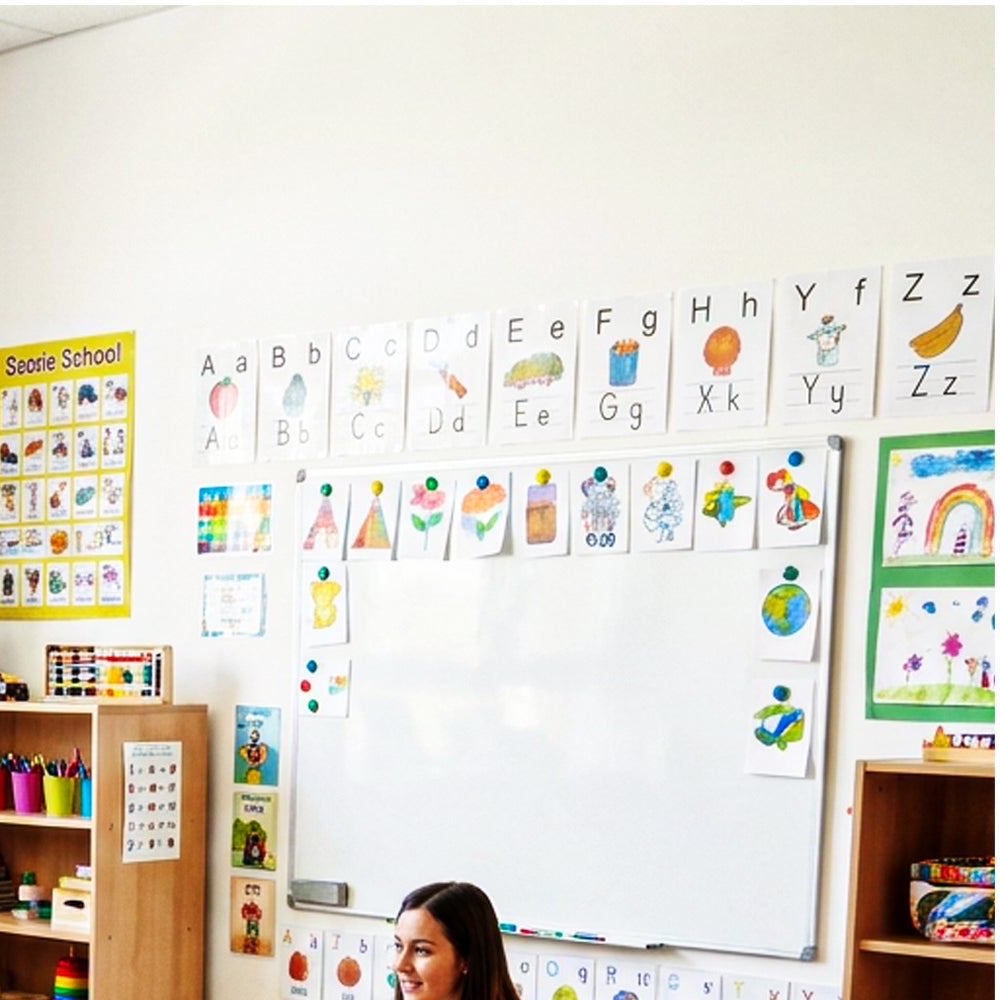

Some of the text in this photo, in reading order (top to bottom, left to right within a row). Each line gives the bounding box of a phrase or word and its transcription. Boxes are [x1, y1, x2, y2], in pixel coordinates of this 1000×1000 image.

[795, 278, 867, 311] Y f
[902, 273, 924, 302] Z
[691, 292, 757, 323] H h
[508, 318, 564, 343] E e
[597, 308, 657, 337] F g
[345, 337, 360, 361] C
[424, 324, 479, 352] D d
[62, 341, 122, 369] School
[201, 355, 247, 376] A a
[272, 342, 321, 368] B b
[803, 374, 844, 414] Y y
[911, 364, 957, 397] Z z
[599, 392, 642, 430] G g
[697, 383, 739, 414] X k
[351, 412, 385, 440] C c
[429, 406, 464, 434] D d
[514, 400, 549, 427] E e
[205, 426, 219, 450] A
[277, 419, 309, 446] B b
